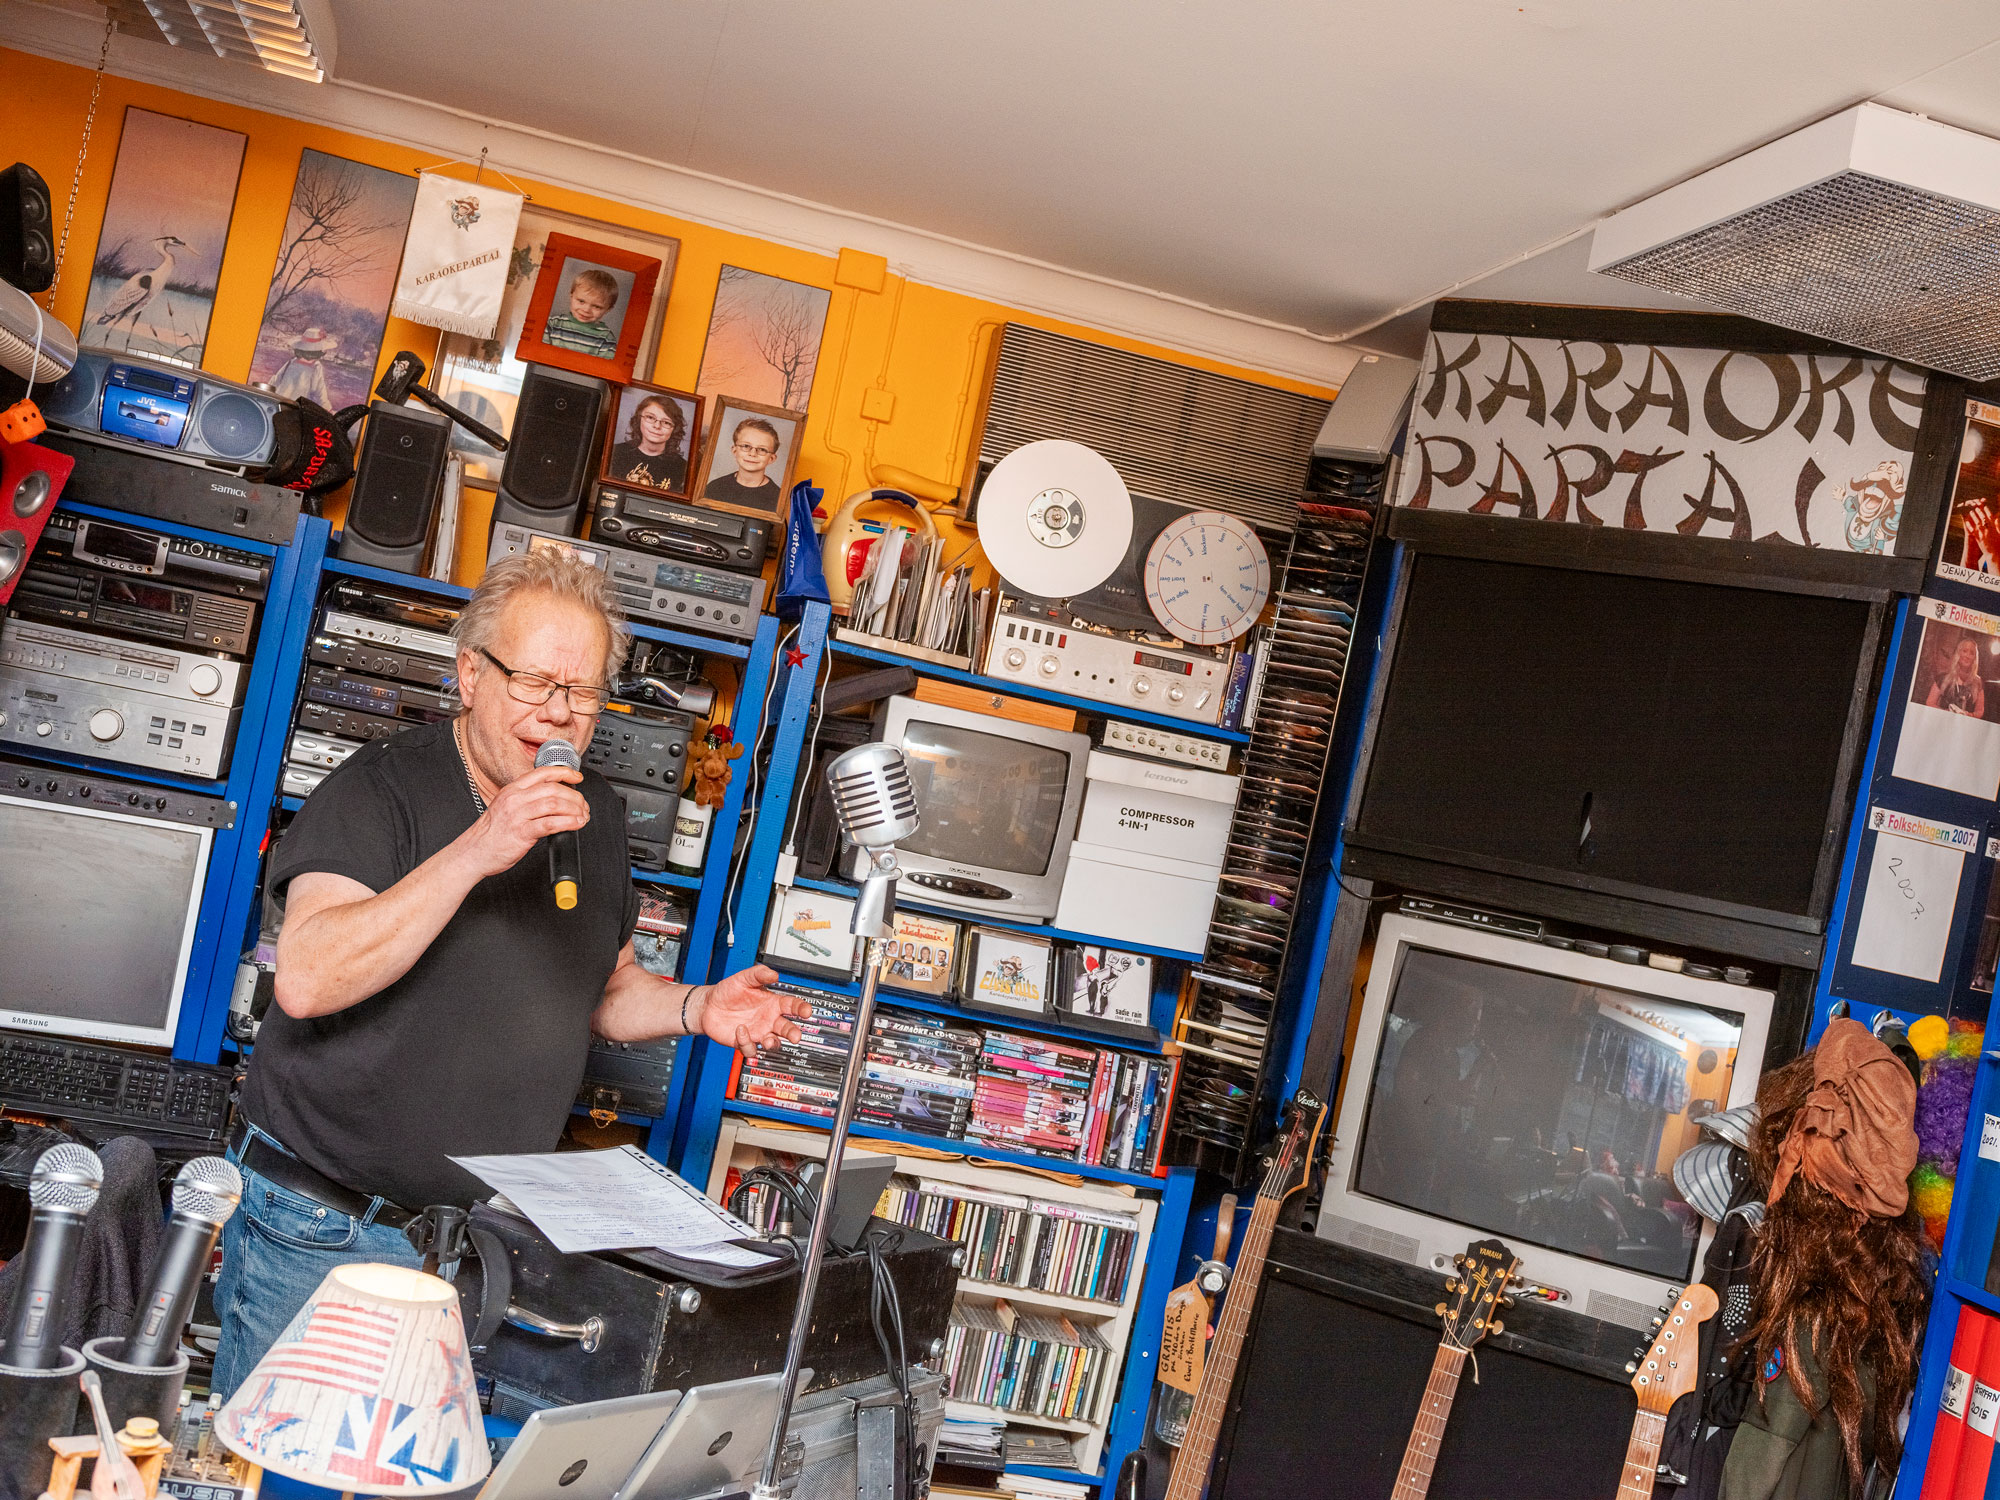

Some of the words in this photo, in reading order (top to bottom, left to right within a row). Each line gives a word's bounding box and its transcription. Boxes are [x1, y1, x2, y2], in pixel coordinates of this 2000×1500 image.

[415, 250, 501, 286] KARAOKEPARTAJ
[1421, 331, 1927, 452] KARAOKE
[137, 396, 156, 406] JVC
[1409, 431, 1826, 549] PARTAJ
[1941, 562, 1976, 584] JENNY
[338, 586, 363, 597] SAMSUNG
[1144, 770, 1189, 785] lenovo
[1118, 818, 1149, 831] 4-IN-1
[1120, 807, 1195, 829] COMPRESSOR
[1886, 813, 1950, 842] Folkschlagern
[1951, 828, 1976, 848] 2007.
[824, 1000, 850, 1011] HOOD
[1115, 1008, 1130, 1017] sadie
[1131, 1011, 1143, 1019] rain
[12, 1016, 49, 1028] SAMSUNG
[892, 1022, 928, 1037] KARAOKE
[750, 1068, 794, 1082] INCEPTION
[775, 1081, 808, 1095] KNIGHT
[816, 1090, 834, 1099] DAY
[1480, 1247, 1502, 1260] YAMAHA
[1162, 1315, 1175, 1372] GRATTIS
